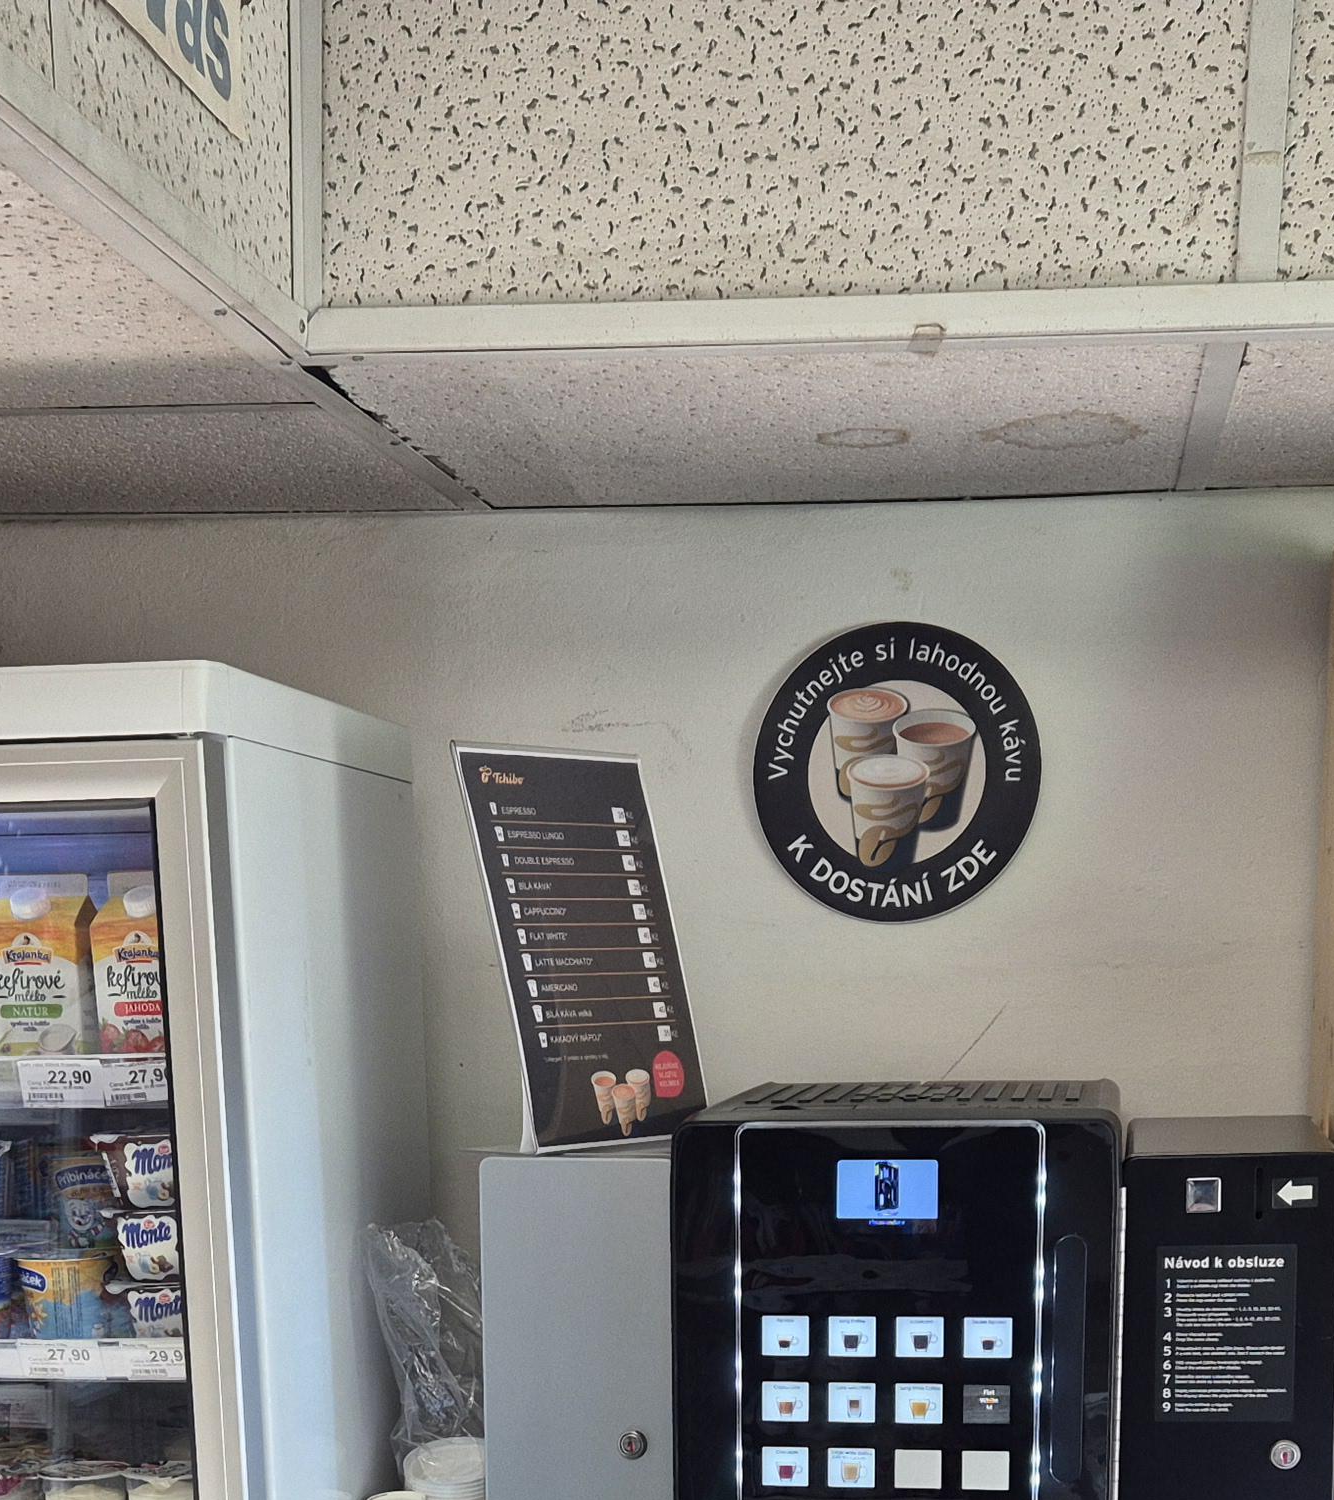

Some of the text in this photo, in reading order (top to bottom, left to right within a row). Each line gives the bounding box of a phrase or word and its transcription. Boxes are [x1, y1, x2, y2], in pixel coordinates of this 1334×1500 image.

[768, 637, 1026, 782] Vychutnejte si lahodnou kávu
[492, 773, 524, 785] Tchibo
[787, 834, 997, 908] K DOSTÁNÍ ZDE
[6, 950, 50, 962] Krajanka
[107, 965, 161, 995] kefírov
[12, 1006, 48, 1017] NATUR
[124, 1003, 161, 1015] JAHODA
[48, 1070, 92, 1087] 22,90
[134, 1149, 173, 1175] Mon
[122, 1222, 172, 1248] Monte
[1164, 1256, 1285, 1269] Návod k obsluze
[1165, 1279, 1171, 1289] 1
[1164, 1293, 1172, 1303] 2
[1164, 1307, 1172, 1318] 3
[1163, 1332, 1172, 1342] 4
[47, 1348, 90, 1363] 27,90
[149, 1350, 183, 1365] 29,9
[1163, 1346, 1172, 1357] 5
[1163, 1360, 1172, 1371] 6
[1163, 1374, 1171, 1384] 7
[1163, 1388, 1172, 1399] 8
[1162, 1402, 1171, 1412] 9
